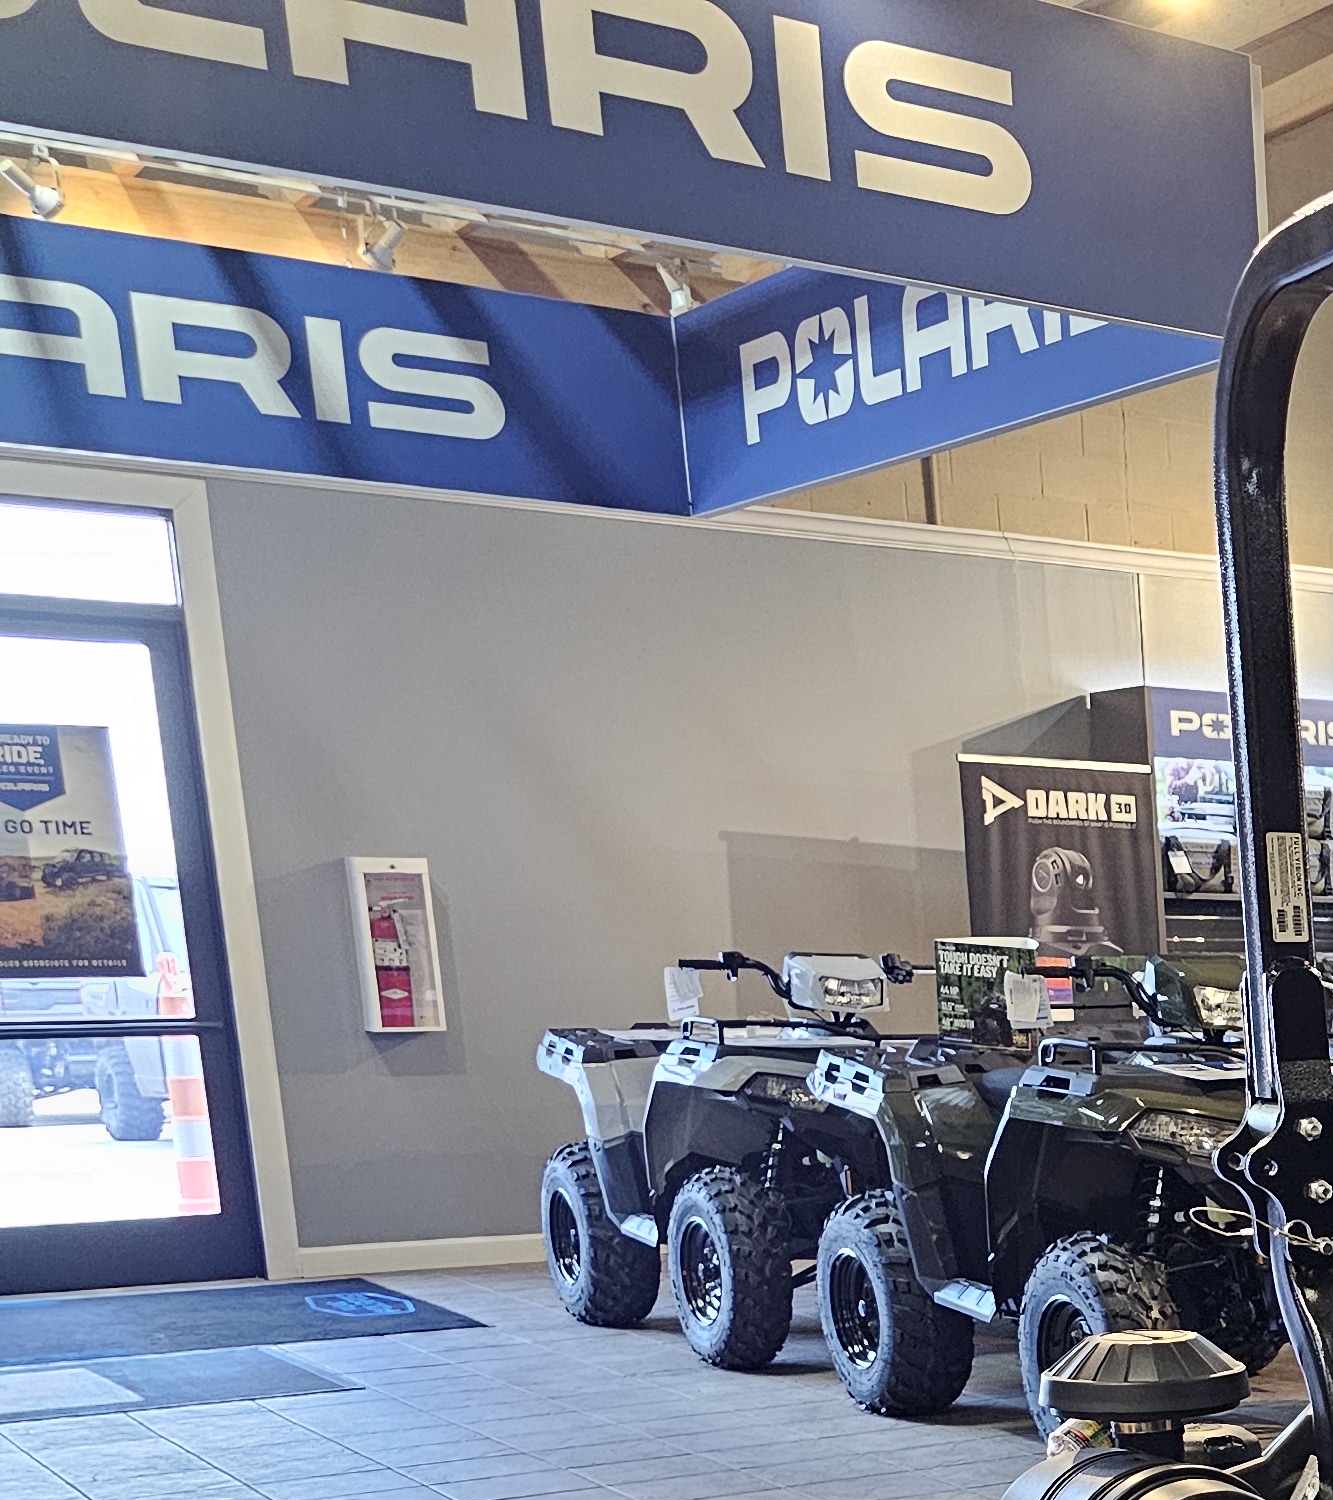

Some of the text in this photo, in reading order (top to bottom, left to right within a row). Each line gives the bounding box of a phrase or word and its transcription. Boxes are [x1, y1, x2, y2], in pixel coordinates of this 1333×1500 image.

[0, 0, 1033, 215] ARIS
[1026, 788, 1132, 822] DARK 30
[4, 818, 94, 836] GO TIME
[937, 950, 1010, 969] TOUGH DOESN'T
[938, 961, 998, 979] TAKE IT EASY
